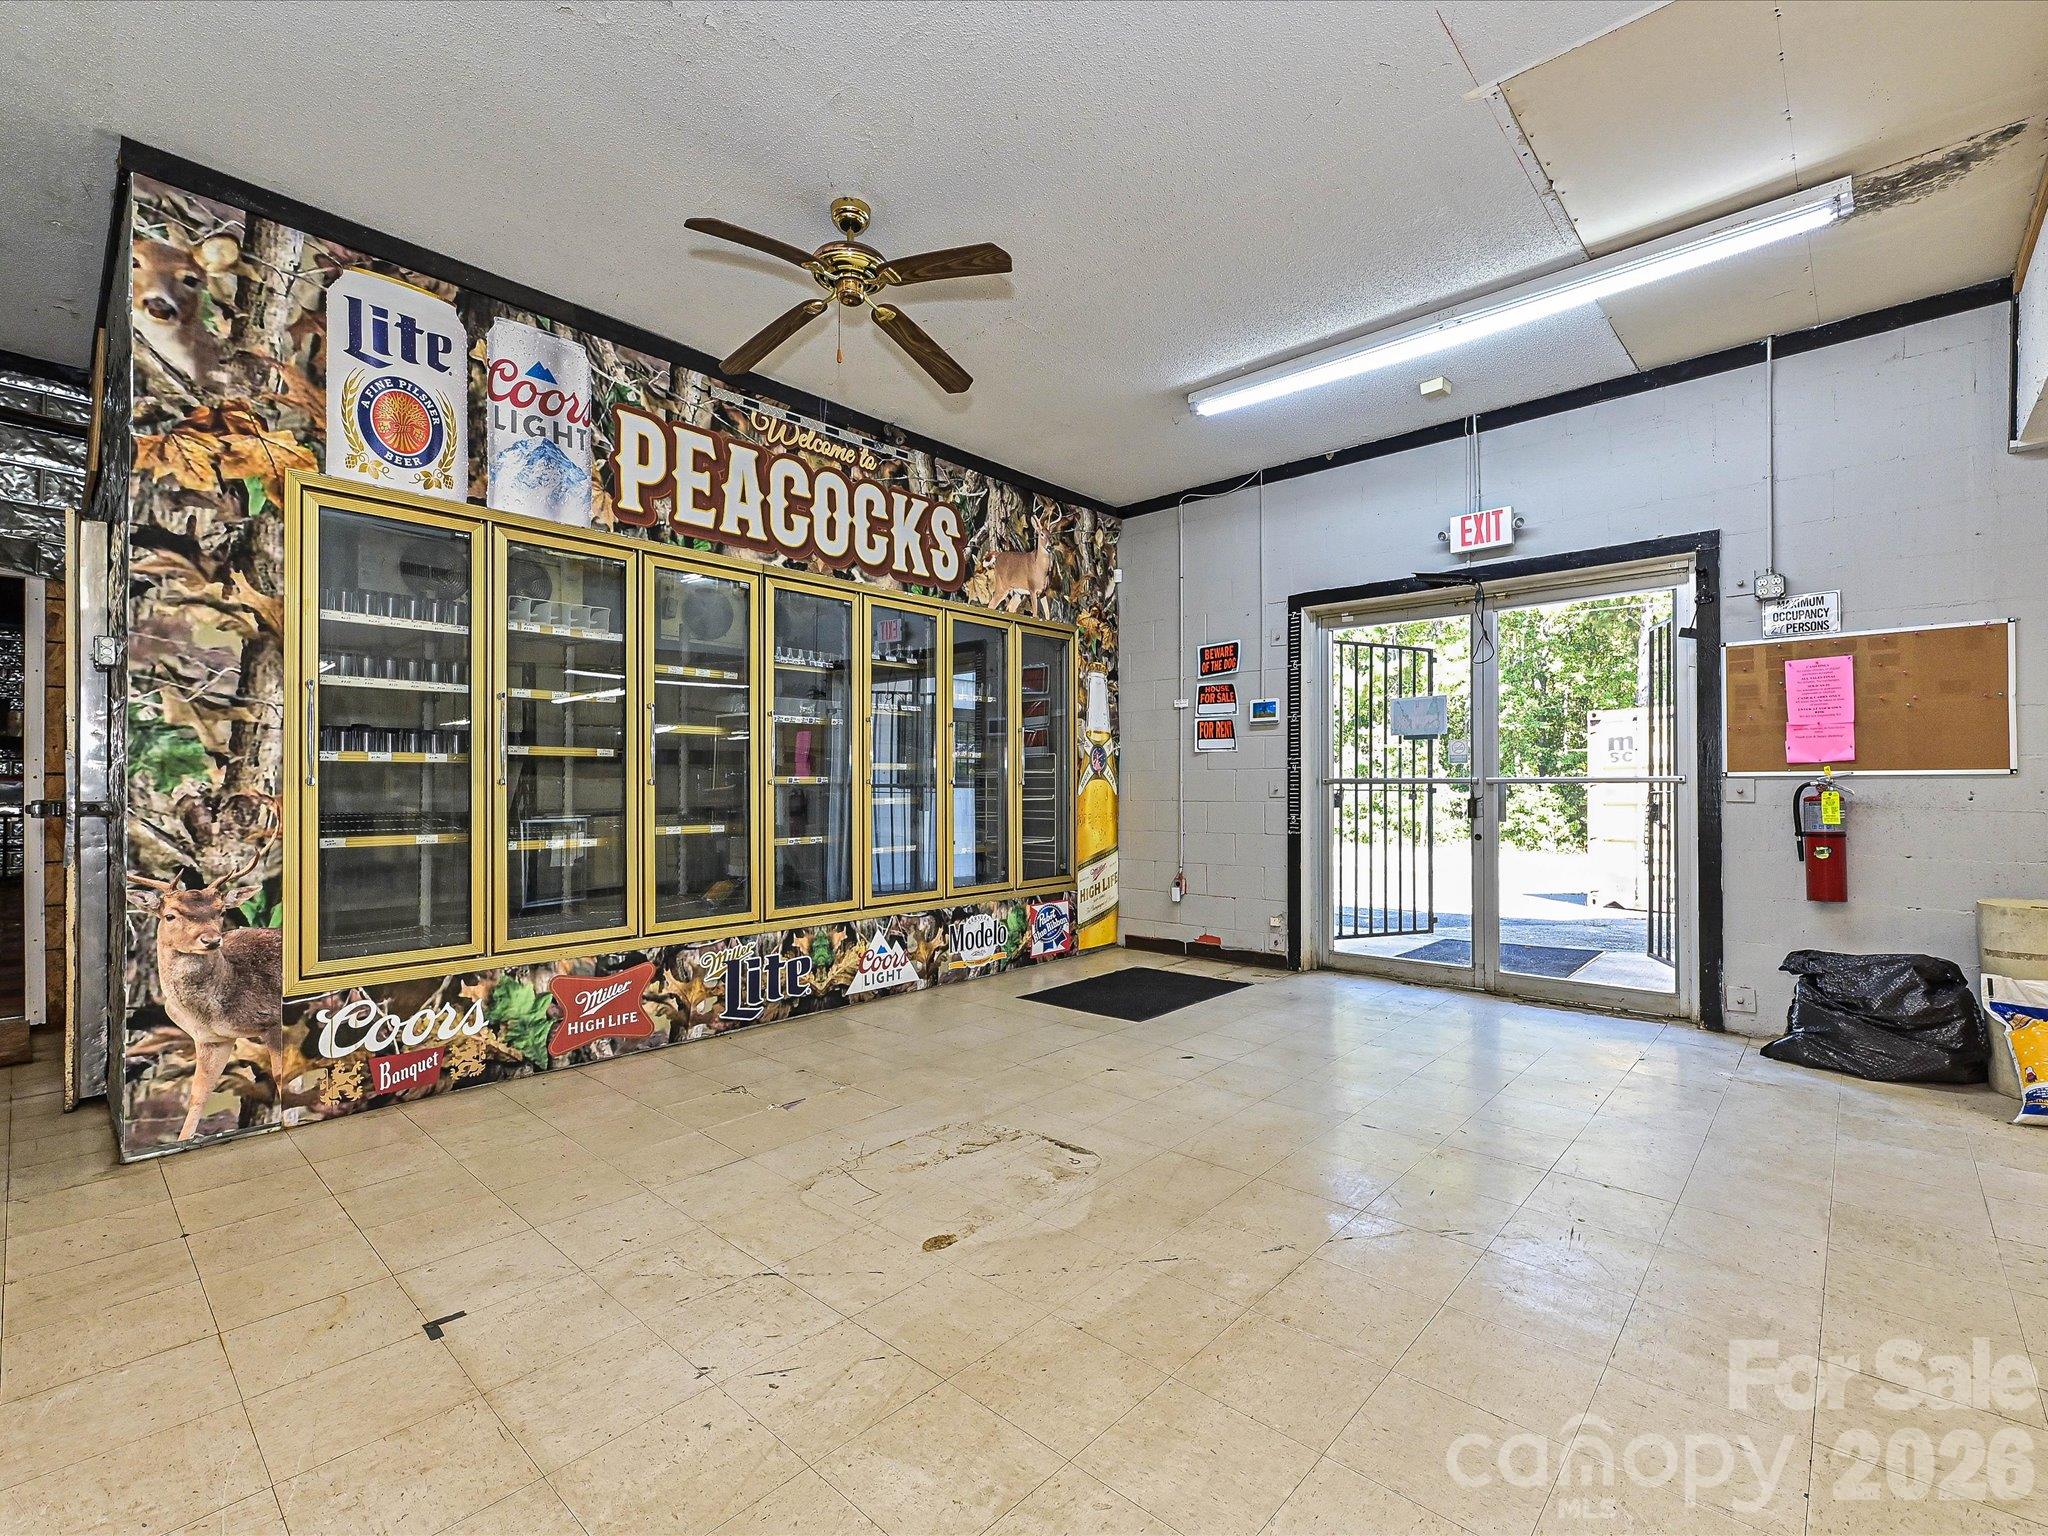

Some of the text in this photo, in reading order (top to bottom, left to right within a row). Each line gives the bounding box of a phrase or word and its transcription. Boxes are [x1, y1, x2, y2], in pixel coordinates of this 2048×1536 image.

[343, 294, 453, 373] Lite
[361, 379, 440, 425] A FINE PILSNER
[487, 358, 592, 427] Coors
[494, 404, 590, 450] LIGHT
[751, 409, 877, 471] Welcome to
[384, 451, 422, 466] BEER
[614, 407, 964, 583] PEACOCKS
[1461, 509, 1503, 547] EXIT
[1772, 608, 1829, 622] OCCUPANCY
[1786, 620, 1829, 634] PERSONS
[1201, 658, 1236, 673] OF THE DOG
[1204, 645, 1234, 660] BEWARE
[1200, 692, 1235, 703] FOR SALE
[1205, 685, 1230, 693] HOUSE
[1199, 720, 1232, 738] FOR RENT
[1080, 871, 1118, 903] HIGH LIFE
[1033, 929, 1048, 943] Blue
[1046, 917, 1068, 931] Ribbon
[1038, 909, 1056, 927] Pabst
[948, 919, 1007, 953] Modelo
[700, 942, 756, 981] Miller
[858, 949, 908, 974] Coors
[865, 969, 902, 986] LIGHT
[575, 980, 632, 1017] Miller
[719, 953, 812, 1020] Lite
[316, 998, 489, 1059] Coors
[567, 1011, 638, 1036] HIGH LIFE
[379, 1051, 439, 1091] Banquet
